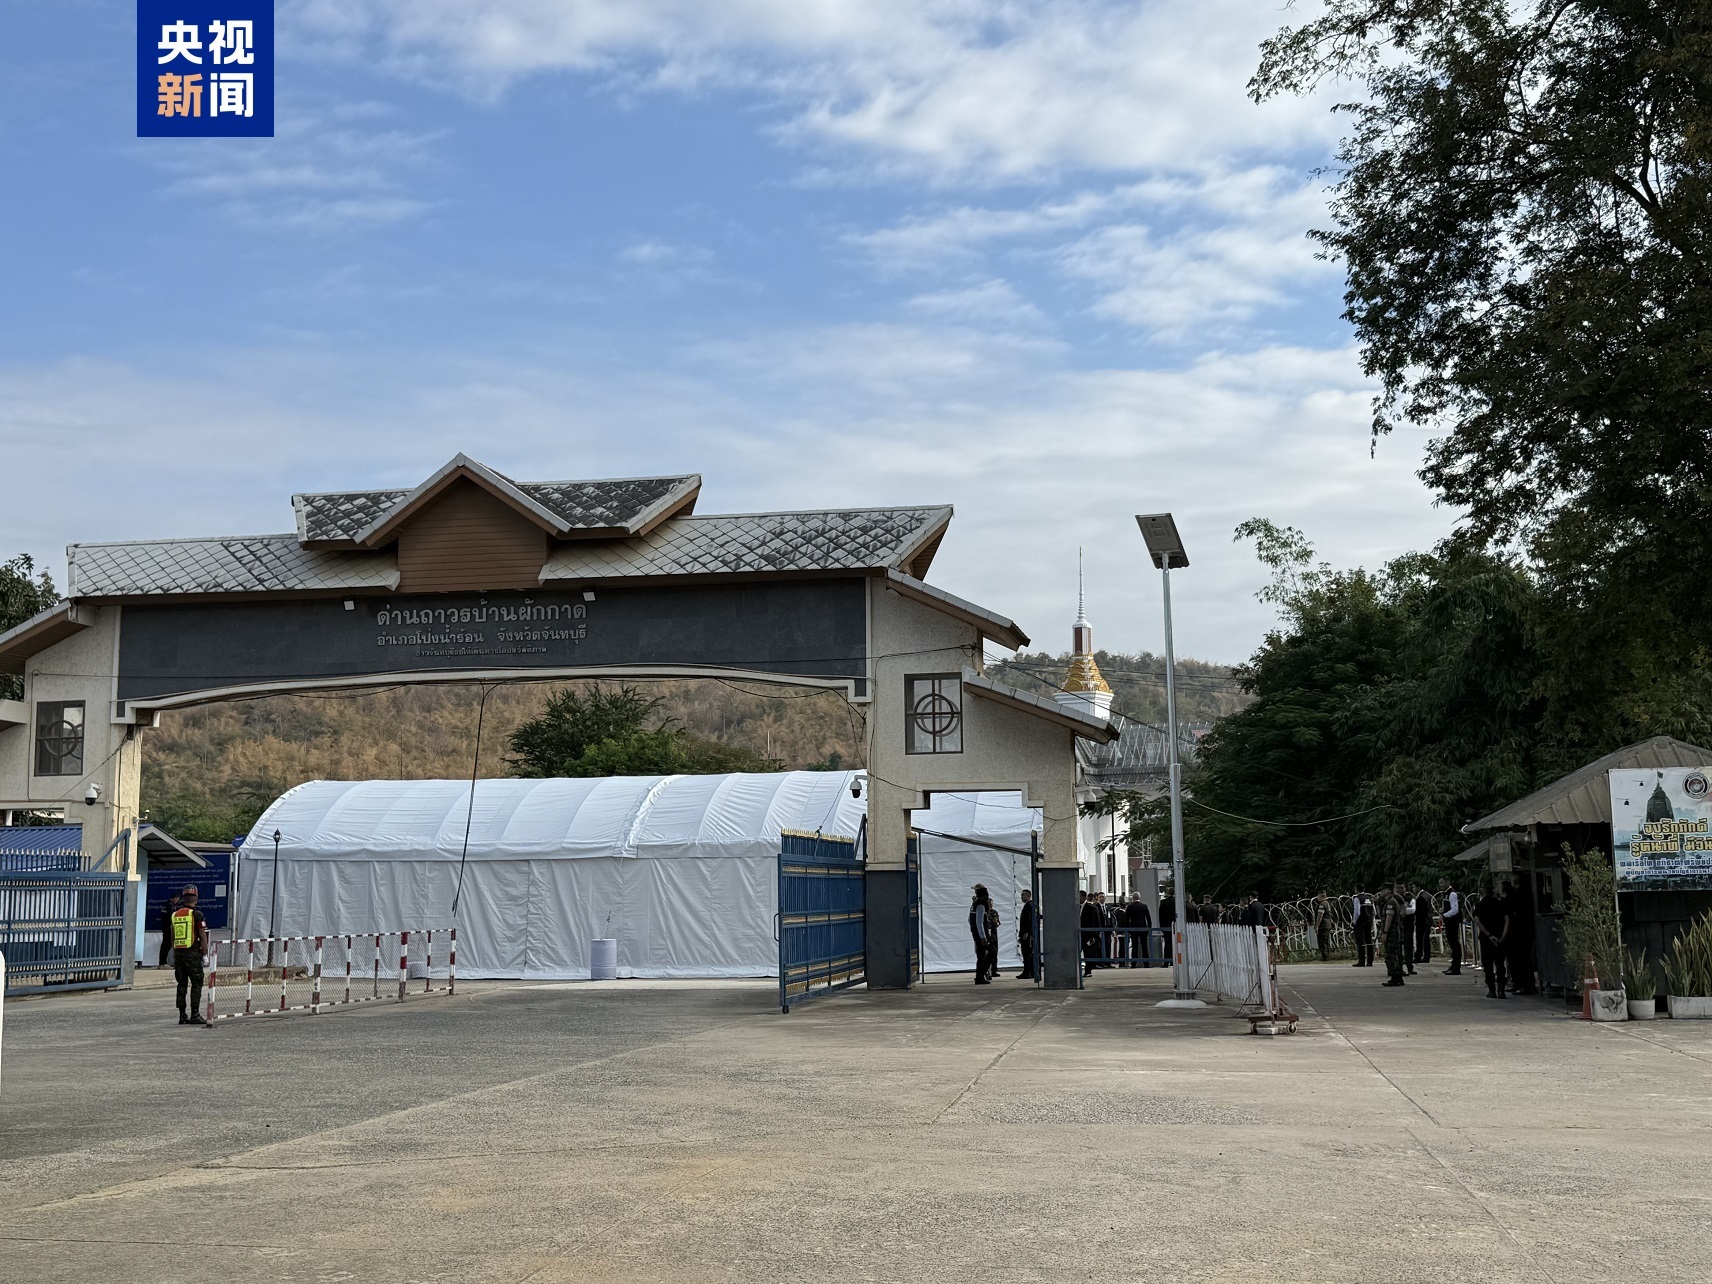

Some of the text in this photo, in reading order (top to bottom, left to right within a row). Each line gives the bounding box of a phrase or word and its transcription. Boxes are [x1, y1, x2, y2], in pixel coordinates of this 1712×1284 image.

[377, 599, 586, 625] ด่านถาวรบ้านผักกาด
[377, 624, 586, 645] อำเภอโป่งน้ำร้อน จังหวัดจันทบุรี
[1644, 818, 1707, 834] จงรักภักดี
[1630, 834, 1679, 857] รู้หน้าที่
